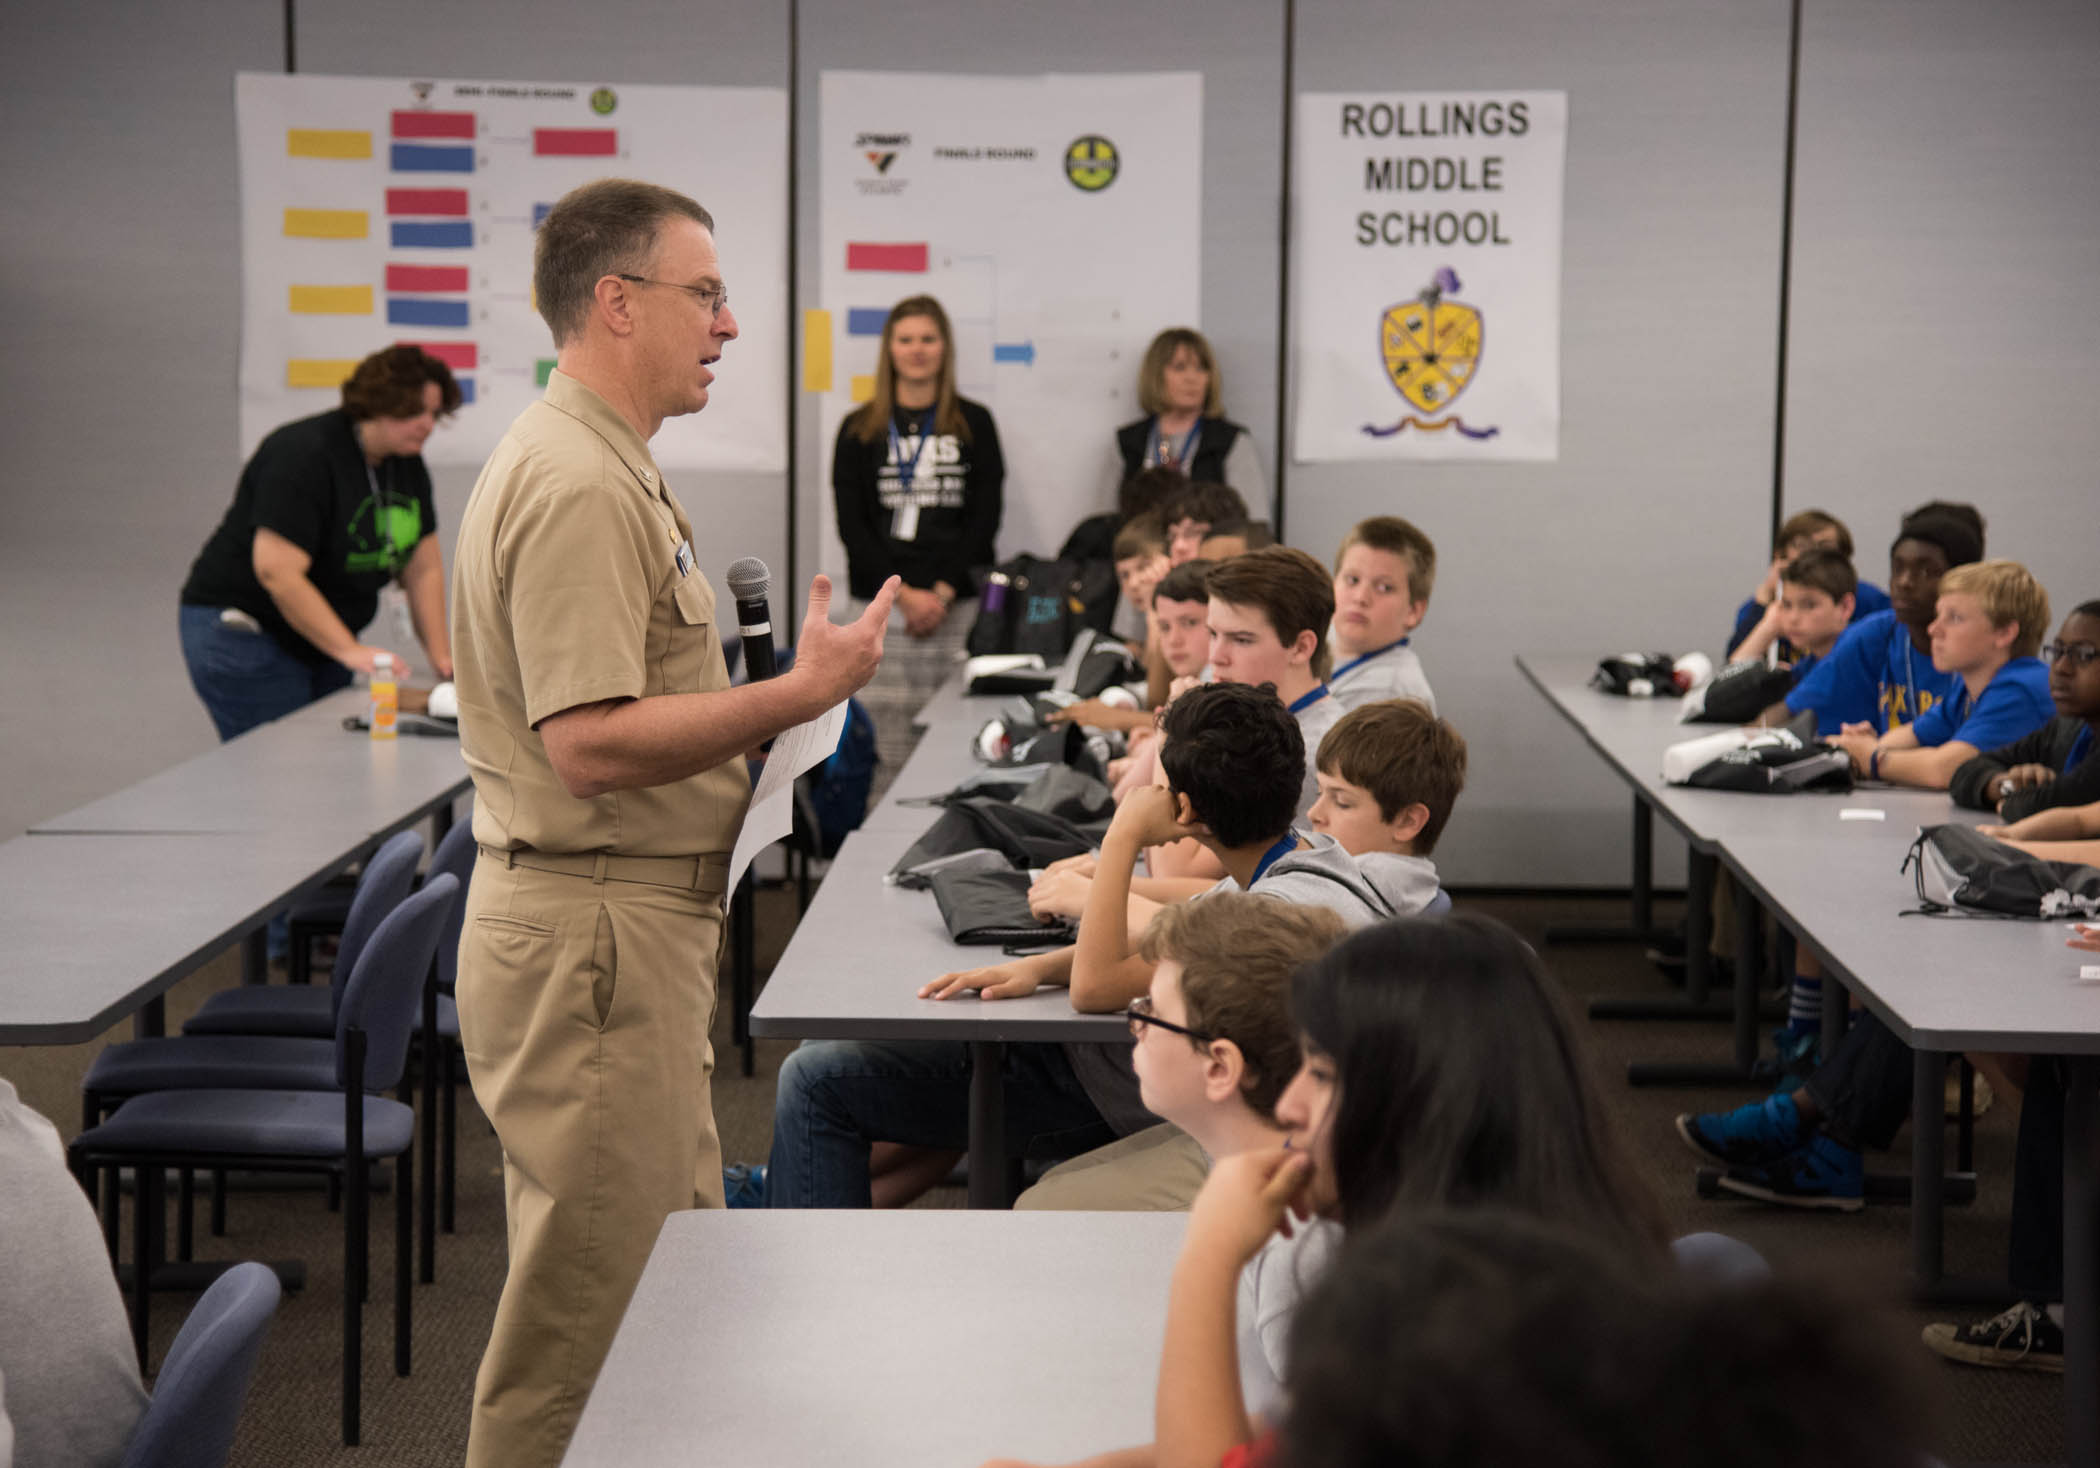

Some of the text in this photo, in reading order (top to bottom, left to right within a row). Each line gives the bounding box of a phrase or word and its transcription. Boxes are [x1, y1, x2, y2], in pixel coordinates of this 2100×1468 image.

[1342, 101, 1530, 138] ROLLINGS
[1365, 156, 1503, 192] MIDDLE
[1356, 211, 1511, 247] SCHOOL
